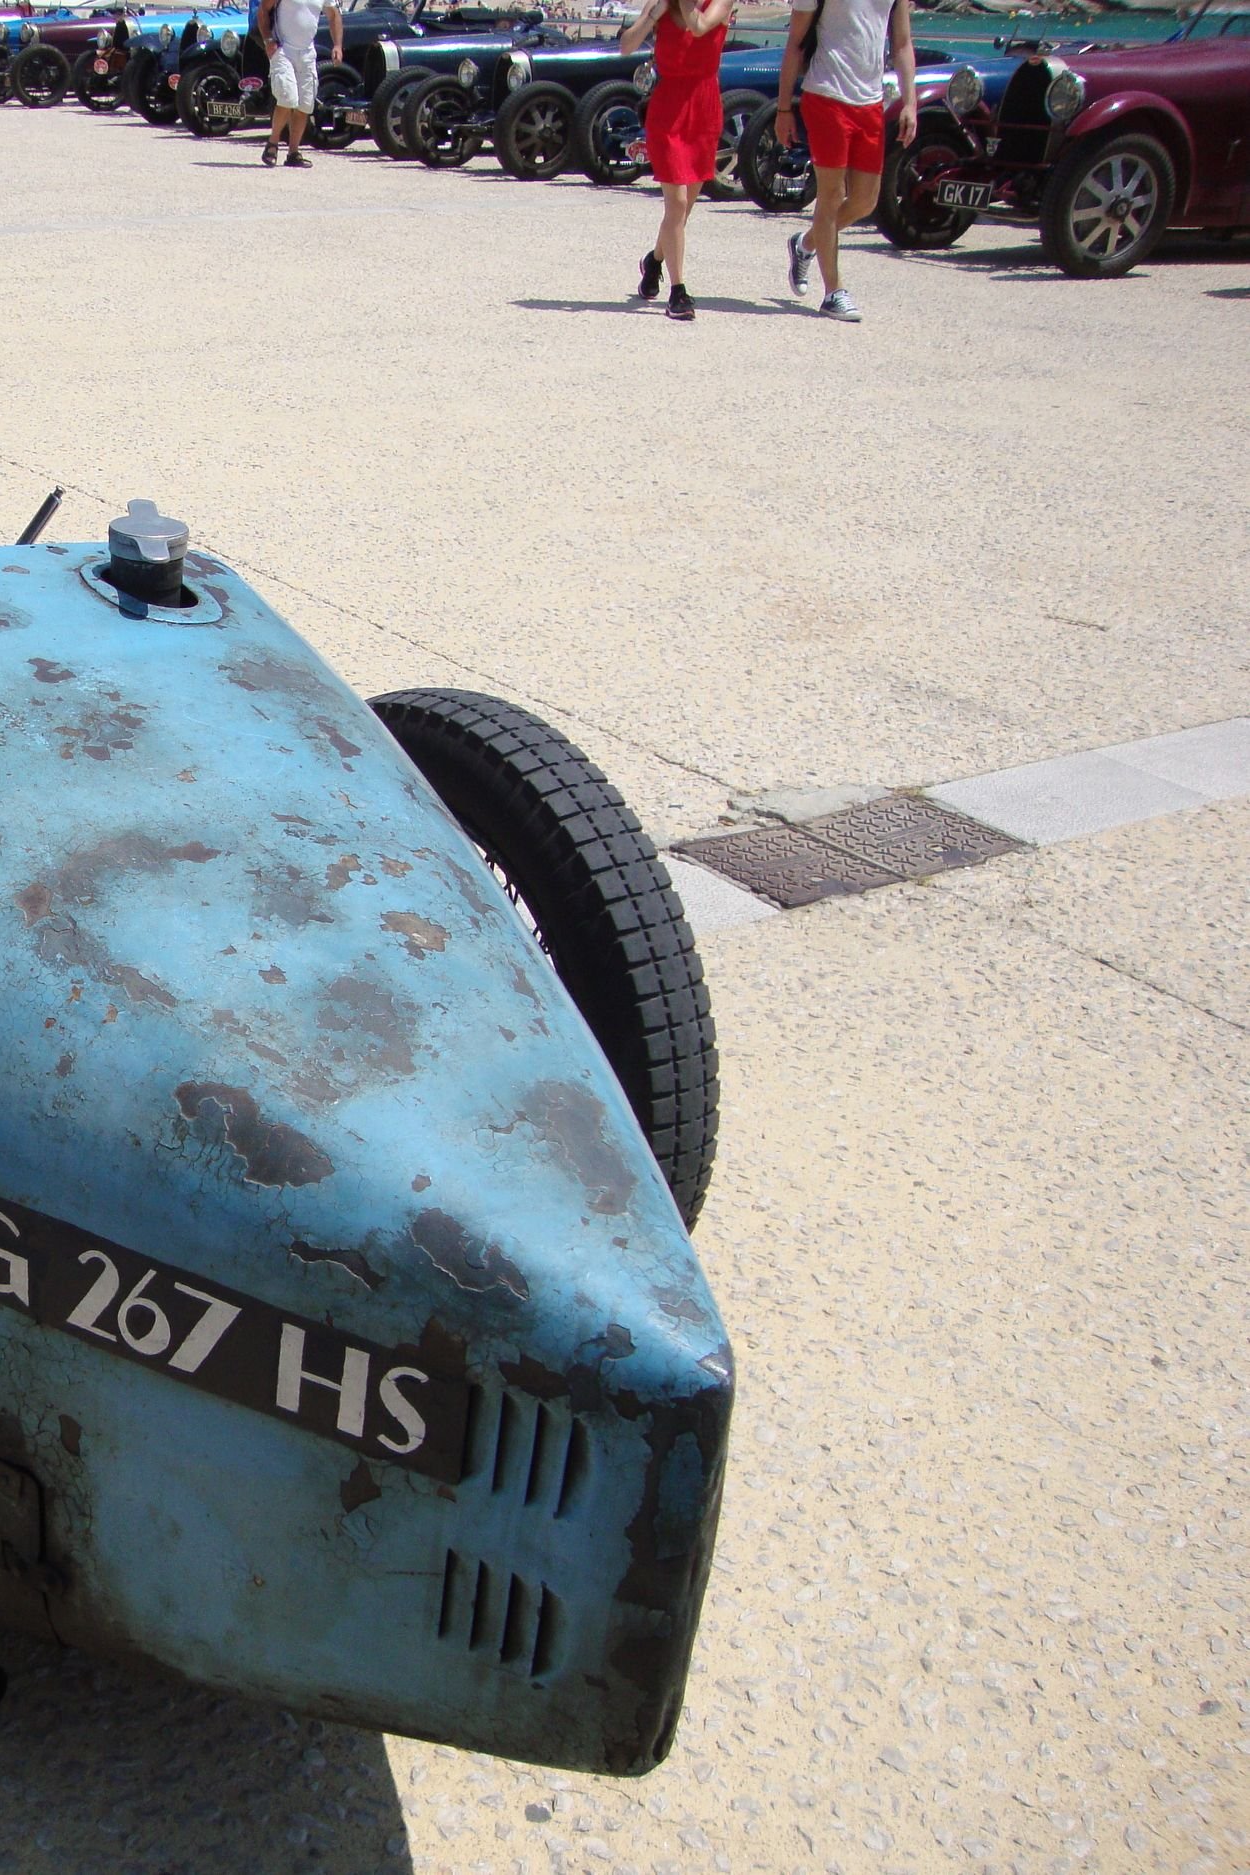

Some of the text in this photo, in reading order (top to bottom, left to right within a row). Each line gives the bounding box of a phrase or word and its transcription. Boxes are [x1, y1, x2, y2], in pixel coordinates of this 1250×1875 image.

[213, 104, 223, 115] BF
[944, 183, 985, 206] GK 17
[65, 1250, 242, 1374] 267
[276, 1323, 428, 1455] HS
